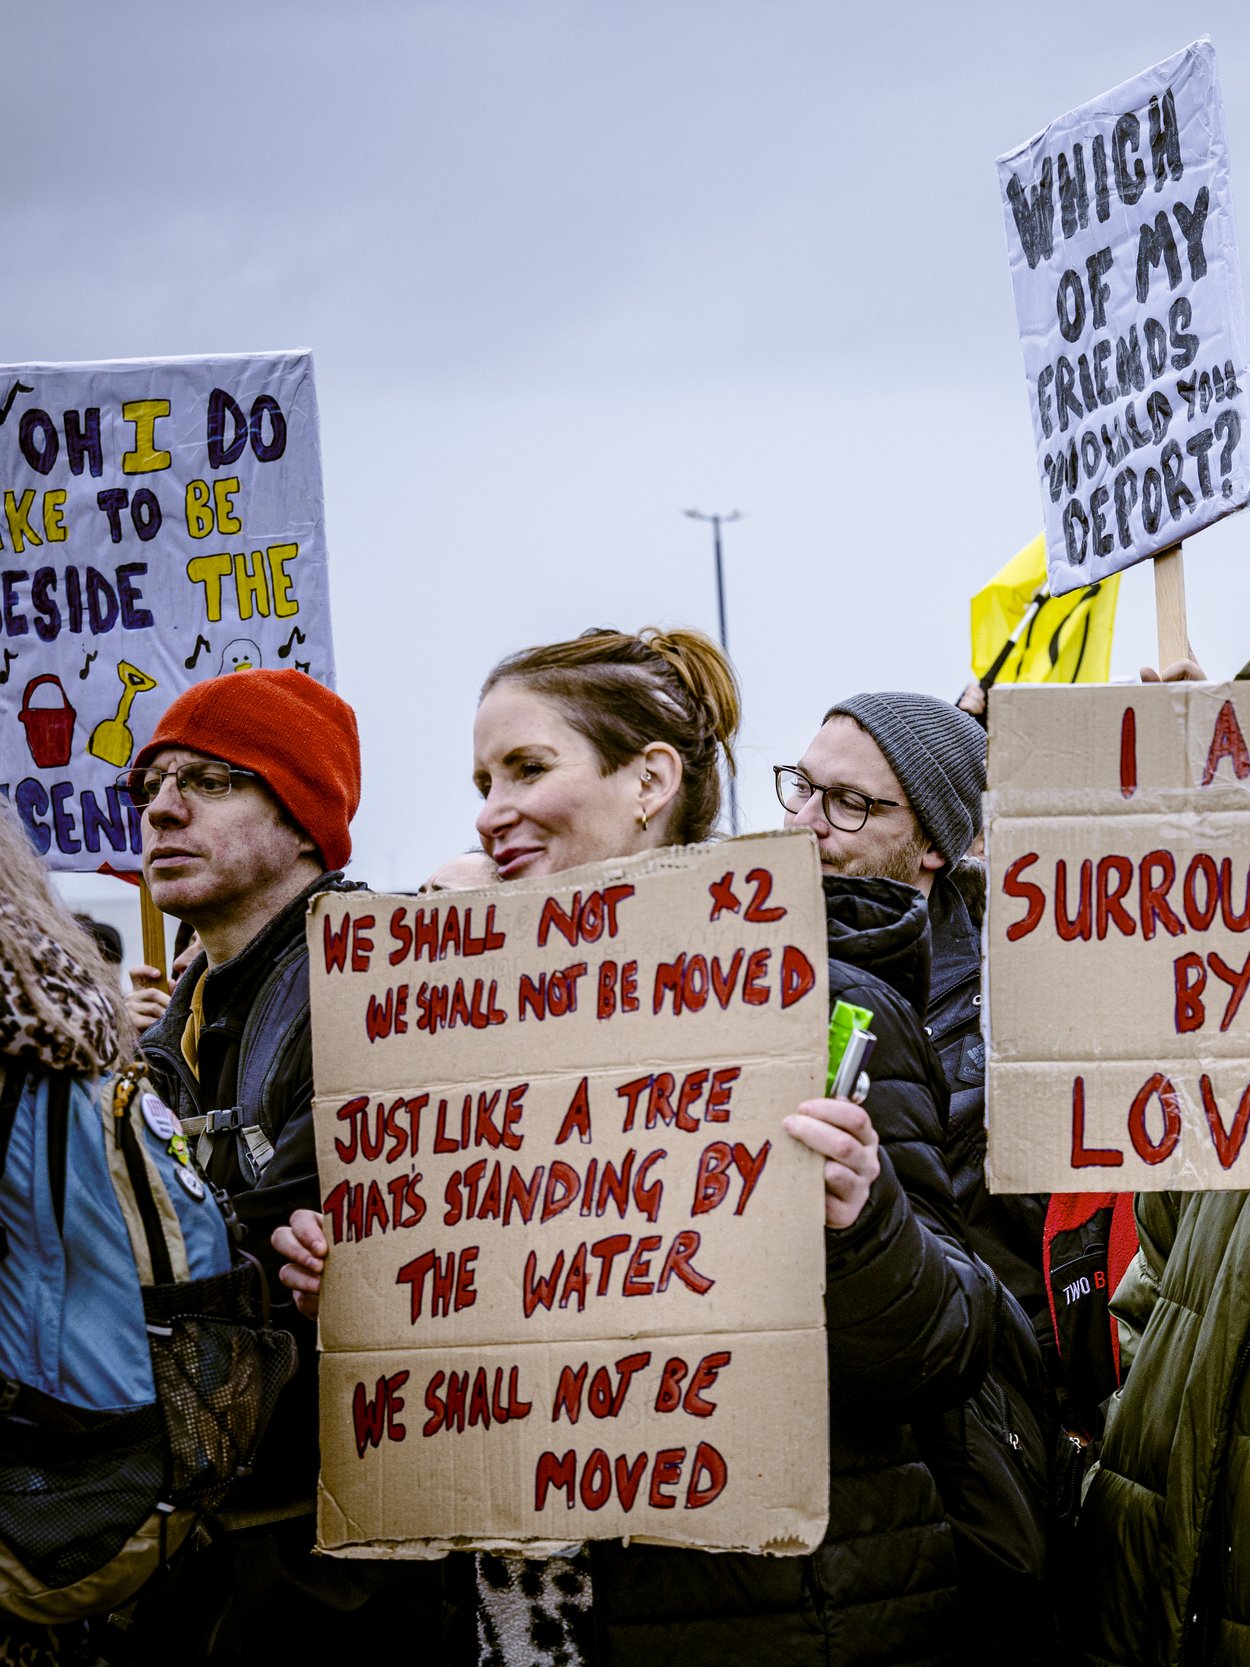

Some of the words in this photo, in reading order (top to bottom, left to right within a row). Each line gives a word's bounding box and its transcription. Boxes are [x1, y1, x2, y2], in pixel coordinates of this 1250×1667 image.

[1006, 88, 1184, 269] WHICH
[1056, 245, 1113, 343] OF
[1135, 185, 1211, 303] MY
[1037, 297, 1200, 439] FRIENDS
[19, 407, 103, 477] OH
[122, 399, 172, 474] I
[207, 388, 287, 469] DO
[1044, 391, 1174, 503] WOULD
[1177, 359, 1242, 419] YOU
[0, 488, 68, 553] KE
[97, 488, 162, 543] TO
[185, 477, 242, 538] BE
[1062, 408, 1242, 567] DEPORT?
[0, 562, 154, 642] ESIDE
[187, 542, 300, 622] THE
[1119, 706, 1138, 799] I
[324, 912, 376, 975] WE
[389, 903, 507, 967] SHALL
[537, 884, 636, 947] NOT
[366, 983, 409, 1044] WE
[416, 977, 507, 1035] SHALL
[518, 962, 588, 1022] NOT
[597, 959, 640, 1021] BE
[653, 945, 816, 1016] MOVED
[334, 1093, 430, 1165] JUST
[433, 1083, 530, 1155] LIKE
[555, 1076, 592, 1145] A
[616, 1067, 741, 1133] TREE
[323, 1164, 427, 1245] THAT'S
[443, 1148, 667, 1227] STANDING
[691, 1140, 771, 1217] BY
[396, 1246, 480, 1326] THE
[523, 1230, 716, 1319] WATER
[1062, 1276, 1091, 1306] TWO
[352, 1370, 410, 1460] WE
[423, 1365, 532, 1437] SHALL
[552, 1351, 651, 1425] NOT
[655, 1351, 731, 1418] BE
[535, 1441, 728, 1514] MOVED
